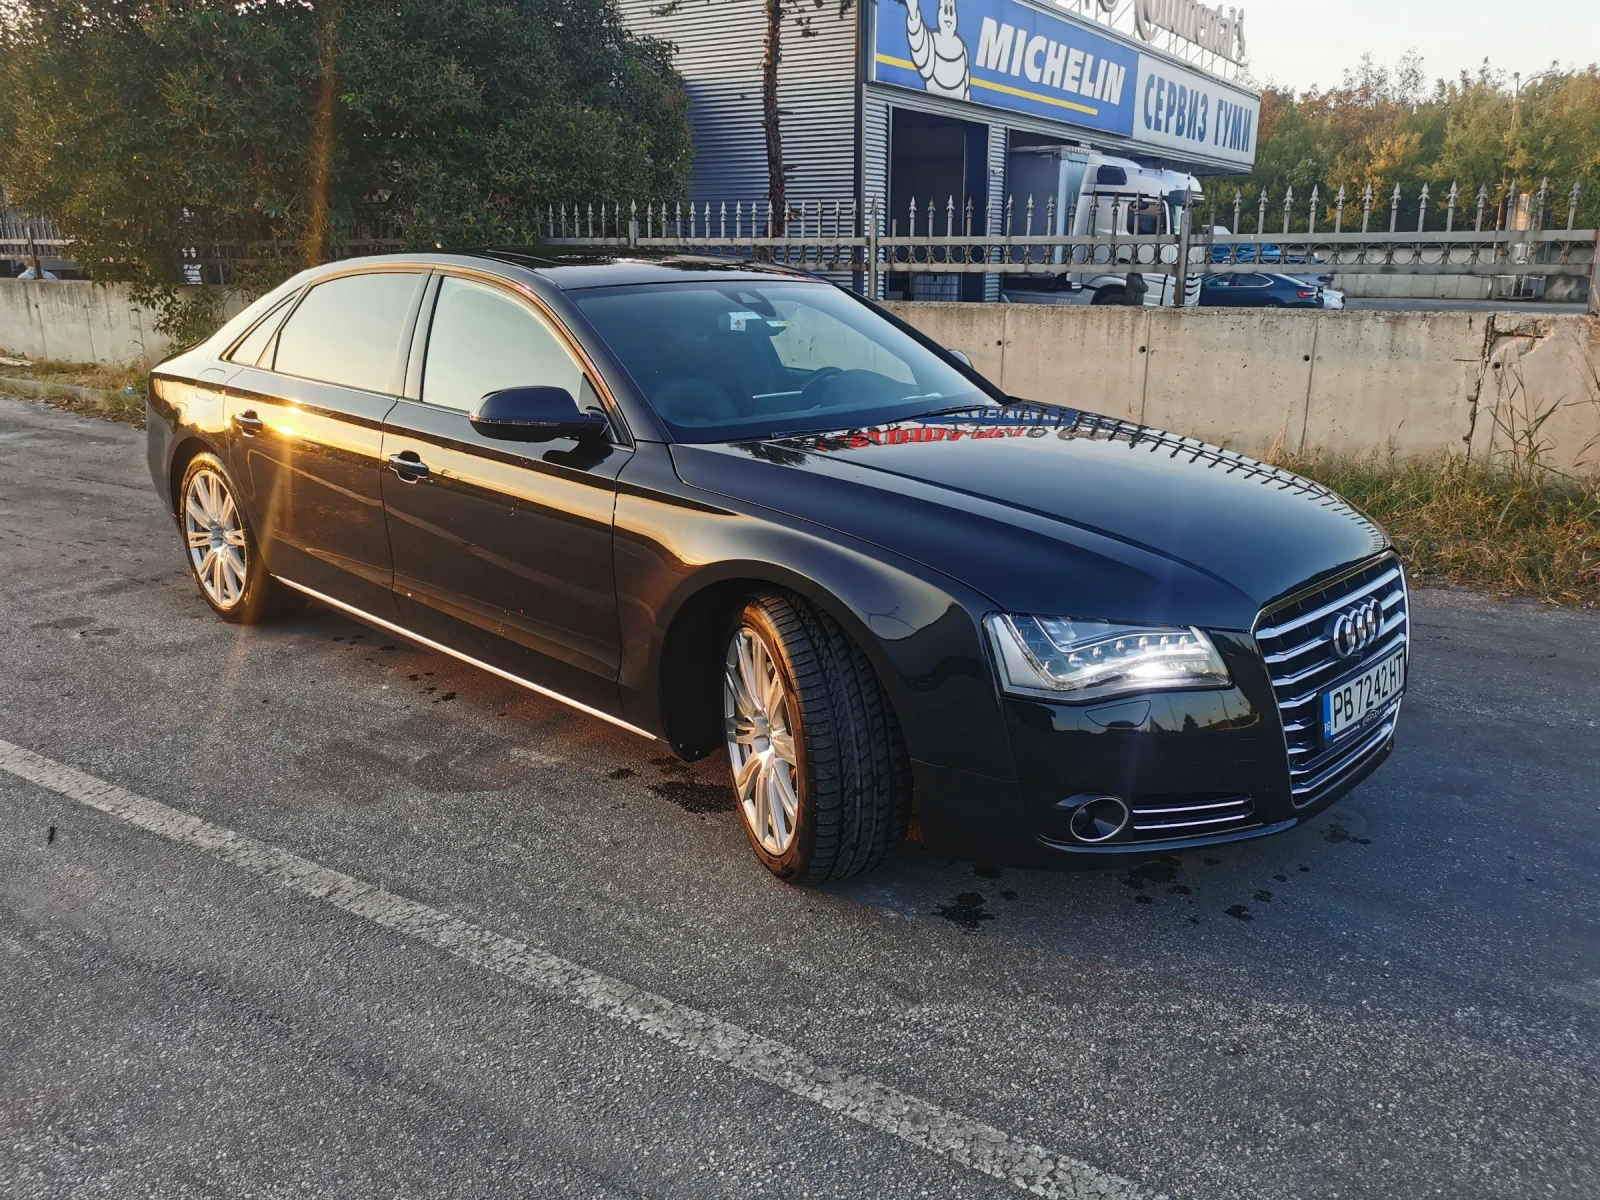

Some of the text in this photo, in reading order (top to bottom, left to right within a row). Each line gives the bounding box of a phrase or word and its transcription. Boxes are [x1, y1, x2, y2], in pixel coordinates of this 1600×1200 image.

[975, 16, 1126, 105] MICHELIN
[1143, 73, 1252, 153] СЕРВИЗ ГУМИ
